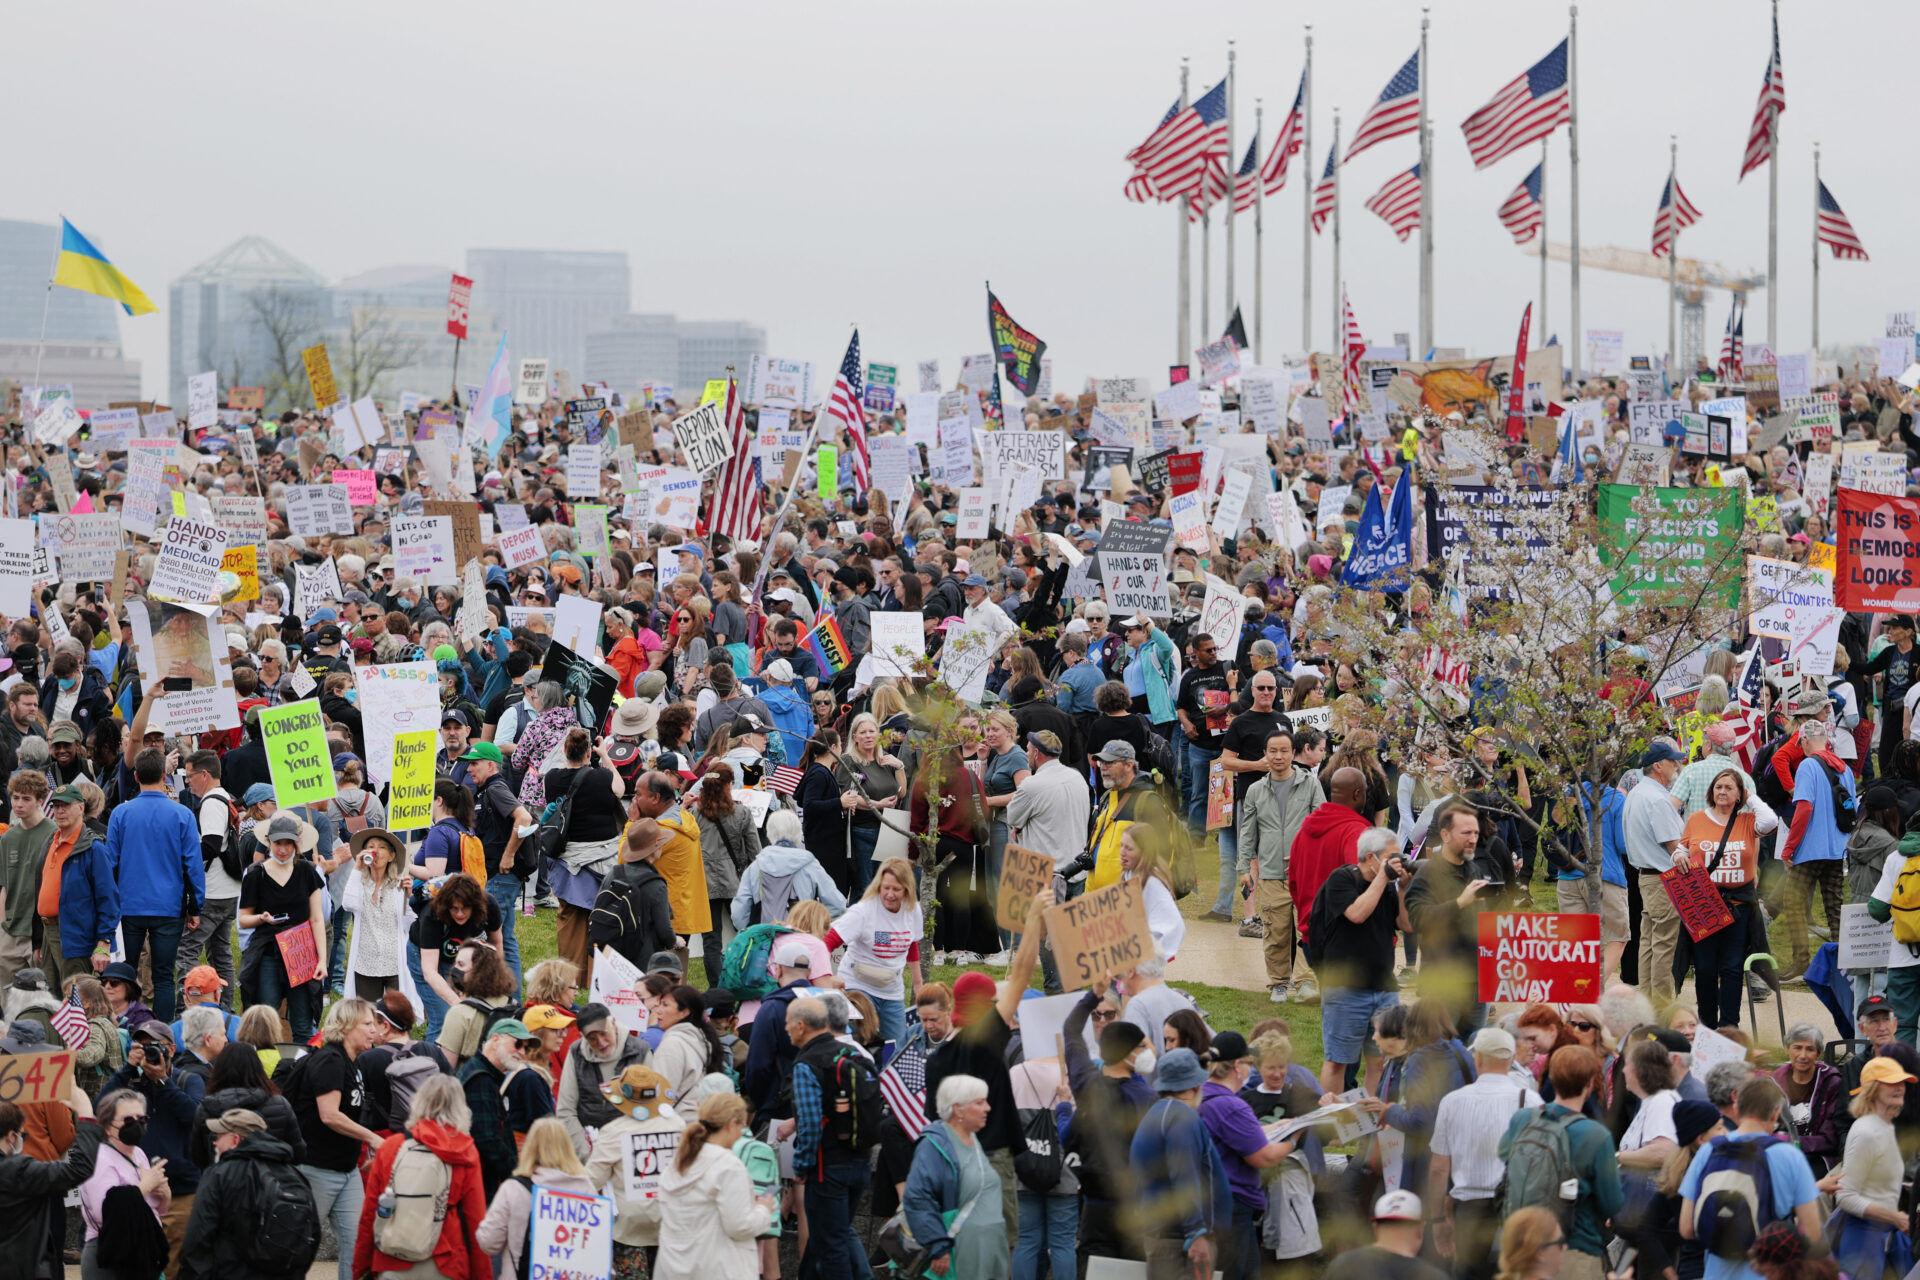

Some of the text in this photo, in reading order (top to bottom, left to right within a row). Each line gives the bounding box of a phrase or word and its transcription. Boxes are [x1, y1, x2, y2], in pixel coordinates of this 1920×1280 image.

[1893, 313, 1910, 325] ALL
[1886, 325, 1916, 338] MEANS
[576, 399, 604, 412] TRANS
[1633, 403, 1681, 421] FREE
[677, 402, 721, 448] DEPORT
[1810, 425, 1833, 438] YOU
[761, 434, 802, 446] RED BLUE
[994, 433, 1061, 448] VETERANS
[688, 432, 727, 474] ELON
[998, 448, 1054, 462] AGAINST
[638, 468, 667, 481] ETURN
[1171, 473, 1200, 485] DEMOC
[663, 479, 698, 492] SENDER
[1482, 491, 1504, 504] NO
[396, 519, 437, 532] LET'S GET
[1842, 509, 1912, 530] THIS IS
[170, 517, 227, 543] HANDS
[1443, 526, 1462, 540] OF
[167, 530, 200, 548] OFF
[399, 537, 408, 547] IN
[502, 528, 536, 550] DEPORT
[1118, 541, 1148, 552] RIGHT
[5, 551, 30, 560] THEIR
[163, 544, 221, 568] MEDICAID
[511, 545, 539, 565] MUSK
[1638, 541, 1706, 560] BOUND
[1849, 538, 1920, 559] DEMOC
[0, 569, 30, 577] OYees!!!
[159, 556, 217, 578] $880 BILLION
[166, 565, 197, 581] MEDICAID
[1107, 557, 1158, 573] HANDS OFF
[1761, 563, 1780, 578] GET
[163, 572, 178, 582] FUND
[178, 576, 190, 585] TAX
[1127, 575, 1146, 589] OUR
[1851, 567, 1913, 586] LOOKS
[152, 580, 210, 602] FOR THE RICH!
[1211, 588, 1240, 608] TRUMP
[1115, 593, 1167, 612] DEMOCRACY
[883, 623, 920, 634] PEOPLE
[1758, 618, 1791, 633] OF OUR
[815, 624, 846, 666] RESIST
[363, 666, 438, 684] 20 LESSON
[181, 689, 206, 699] Faliero,
[167, 701, 187, 710] Doge
[192, 697, 213, 706] Venice
[170, 707, 203, 717] EXECUTED
[165, 716, 199, 727] attempting
[205, 713, 221, 722] coup
[264, 711, 322, 738] CONGRESS
[286, 740, 310, 755] DO
[396, 740, 427, 754] Hands
[284, 755, 322, 773] YOUR
[395, 754, 413, 769] Off
[293, 774, 324, 791] DUTY
[392, 784, 433, 799] VOTING
[392, 803, 432, 820] RIGHTS!
[1005, 849, 1049, 878] MUSK
[1002, 871, 1045, 898] MUST
[1710, 869, 1745, 883] ATTER
[1063, 882, 1133, 927] TRUMP'S
[1668, 878, 1702, 929] LOOKS LIKE
[1677, 871, 1723, 930] EMOCRACY
[1081, 913, 1129, 950] MUSK
[1496, 914, 1558, 938] MAKE
[1478, 938, 1600, 964] The AUTOCRAT
[1496, 959, 1527, 980] GO
[1494, 979, 1554, 1002] AWAY
[632, 1132, 683, 1150] HAND
[633, 1149, 674, 1177] OF
[633, 1182, 659, 1190] NATIONA
[540, 1195, 600, 1227] HANDS
[554, 1224, 591, 1249] OFF
[549, 1245, 575, 1260] MY
